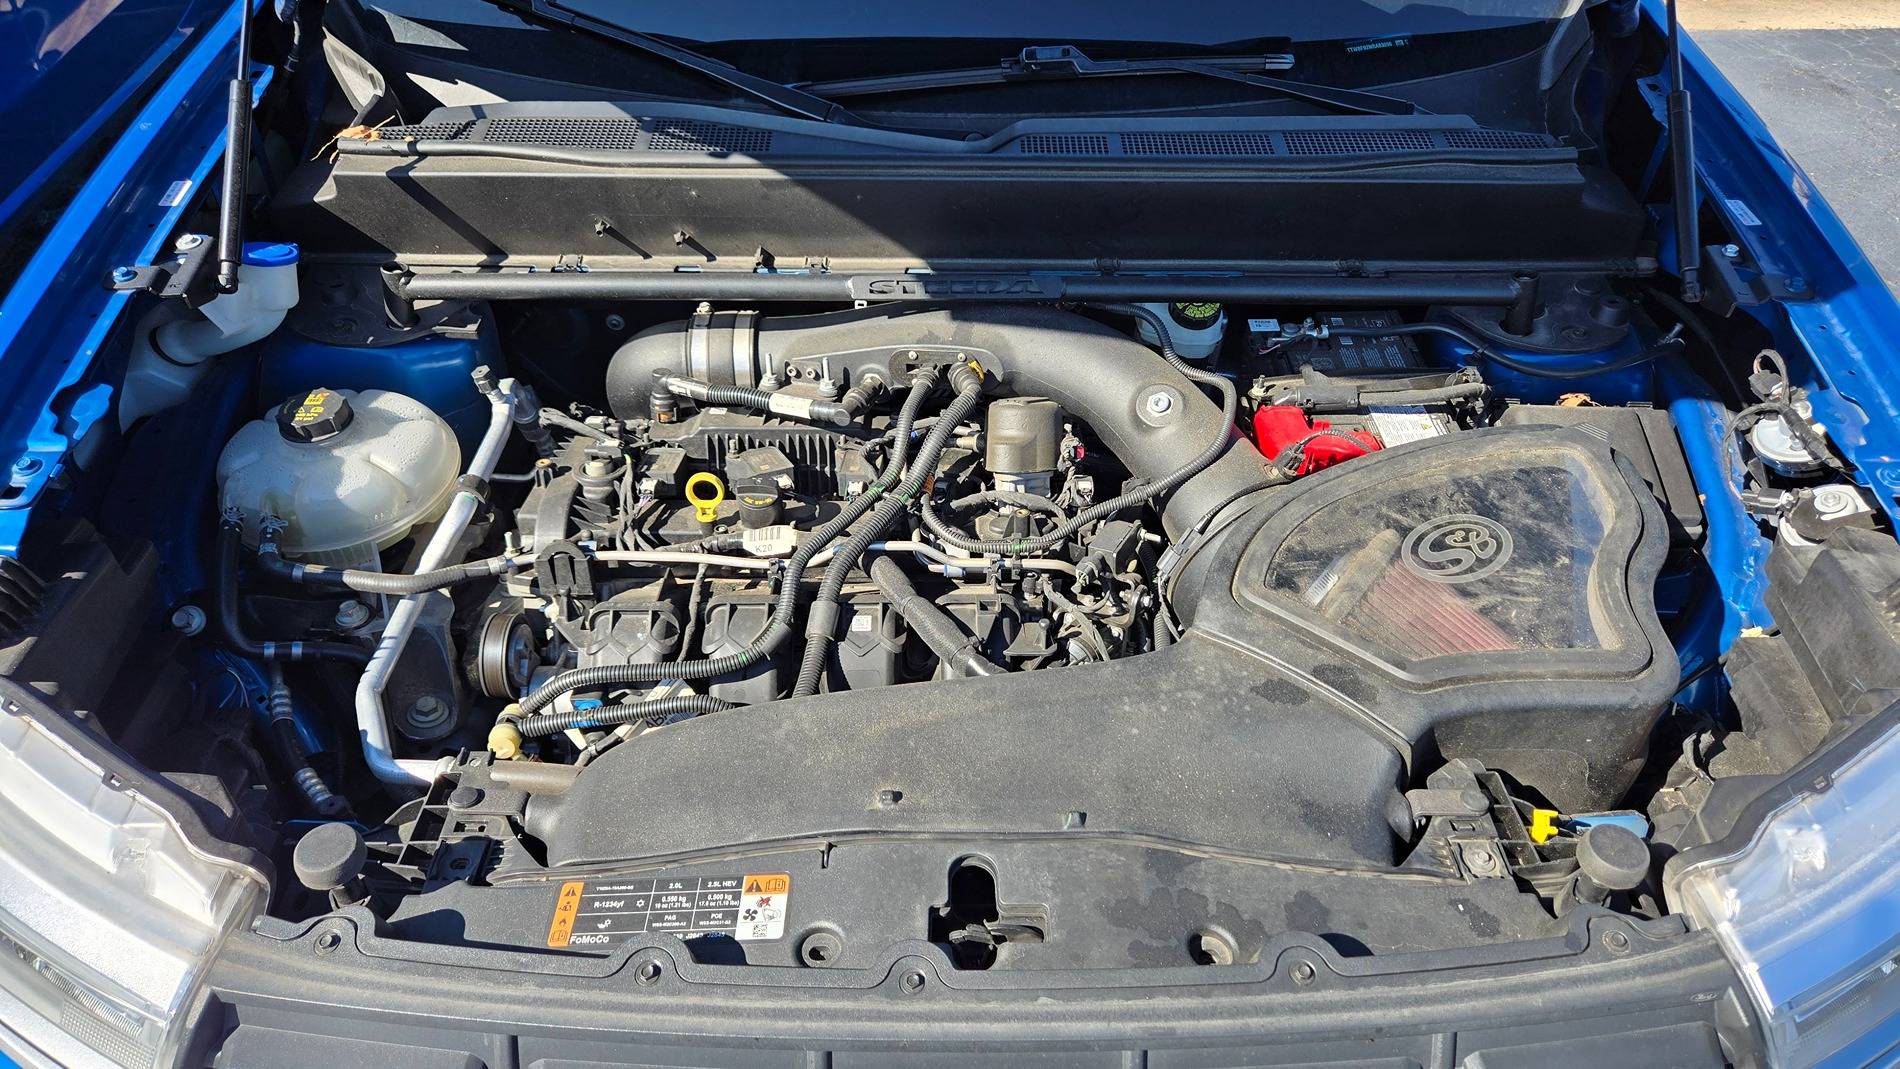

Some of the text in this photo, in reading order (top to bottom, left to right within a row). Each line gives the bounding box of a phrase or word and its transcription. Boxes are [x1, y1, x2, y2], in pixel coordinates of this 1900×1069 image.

[868, 279, 1045, 294] STEEDA
[755, 544, 773, 553] K20
[1417, 523, 1497, 576] S&B
[678, 895, 687, 903] kg
[724, 893, 733, 901] kg
[593, 900, 625, 909] R-1234yf
[569, 935, 610, 945] FoMoCo
